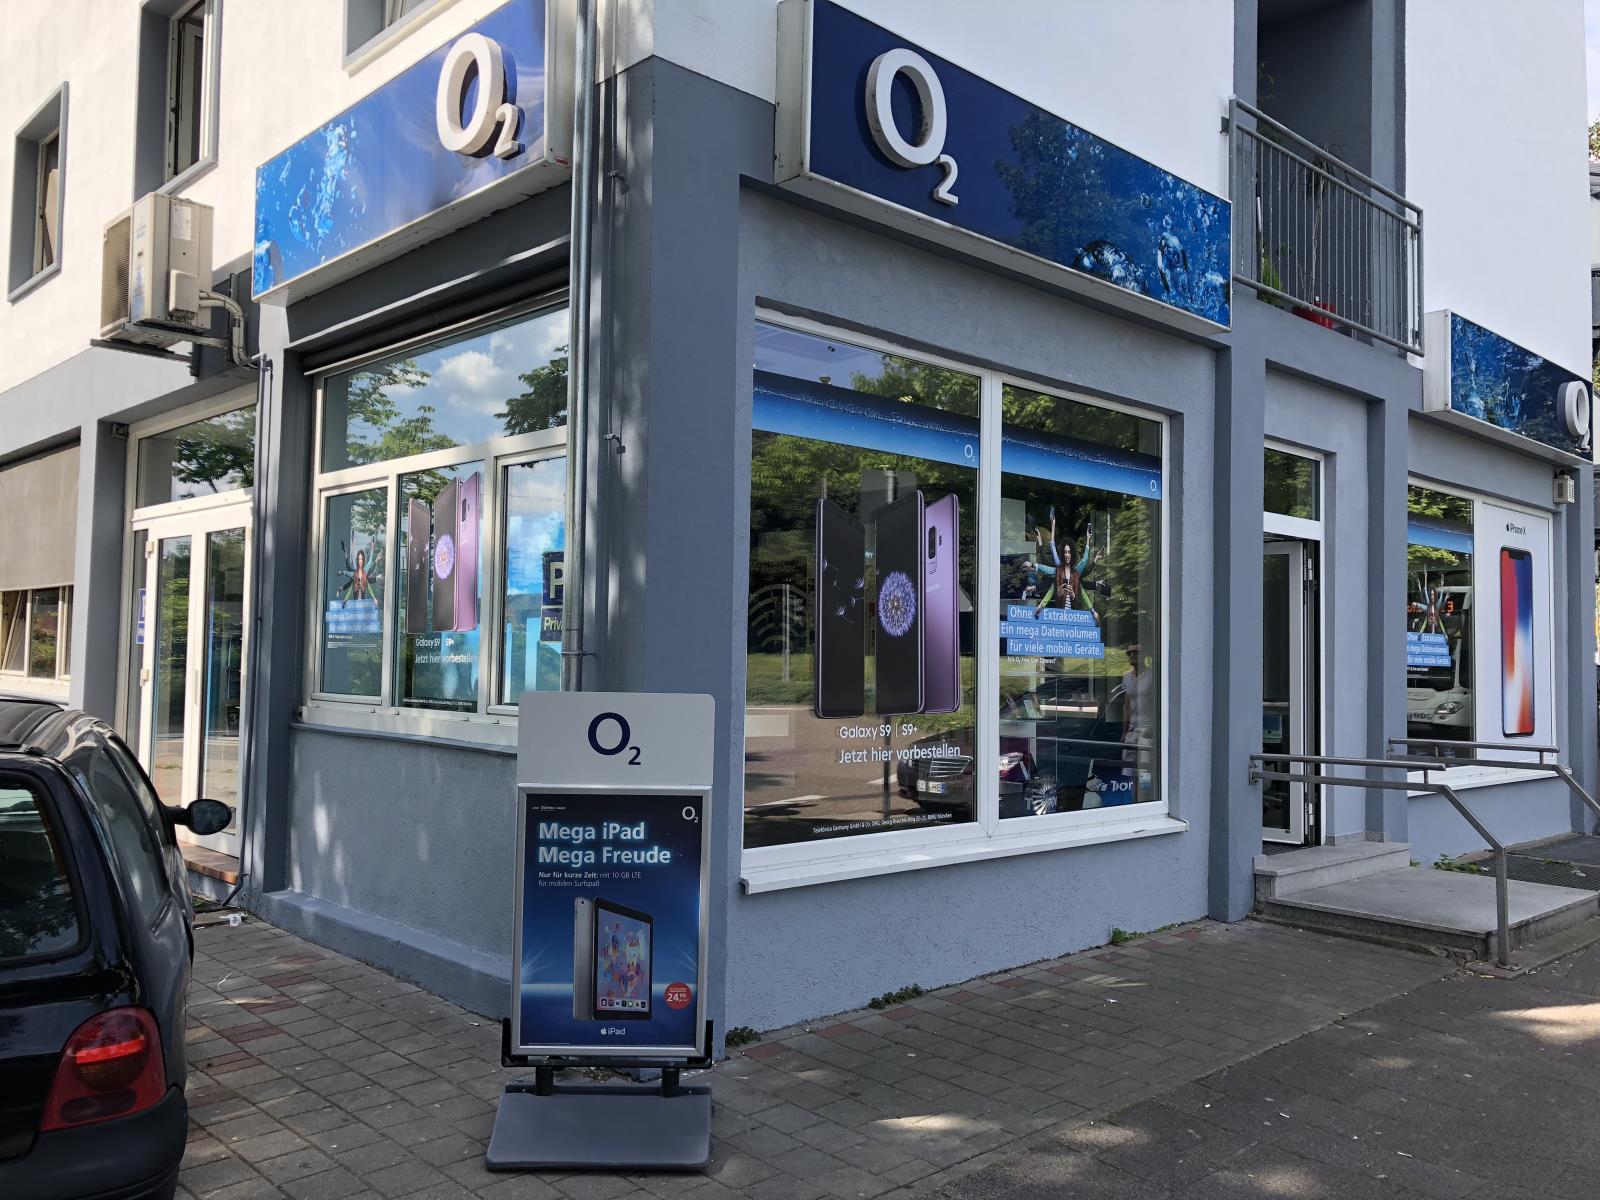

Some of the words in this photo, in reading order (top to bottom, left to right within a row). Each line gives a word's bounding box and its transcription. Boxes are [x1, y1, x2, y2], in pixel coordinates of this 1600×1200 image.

[866, 48, 958, 204] O2
[550, 562, 563, 598] P
[1010, 606, 1033, 619] Ohne
[1044, 609, 1091, 623] Extrakosten:
[544, 616, 562, 631] Priv
[1001, 623, 1014, 635] Ein
[1016, 626, 1039, 639] mega
[1042, 626, 1098, 639] Datenvolumen
[416, 638, 434, 649] Galaxy
[1010, 640, 1022, 652] für
[1024, 642, 1044, 653] viele
[1046, 643, 1073, 655] mobile
[1074, 644, 1102, 656] Geräte.
[415, 654, 428, 664] Jetzt
[430, 653, 441, 664] hier
[588, 712, 641, 766] O2
[840, 726, 878, 740] Galaxy
[880, 724, 891, 737] S9
[902, 723, 918, 736] S9+
[840, 749, 868, 764] Jetzt
[871, 747, 893, 761] hier
[896, 743, 961, 760] vorbestellen
[682, 806, 698, 823] O2
[539, 822, 596, 844] Mega
[602, 822, 645, 840] iPad
[539, 846, 595, 868] Mega
[602, 846, 671, 864] Freude
[574, 880, 600, 888] Surfspaß
[608, 1028, 626, 1036] iPad
